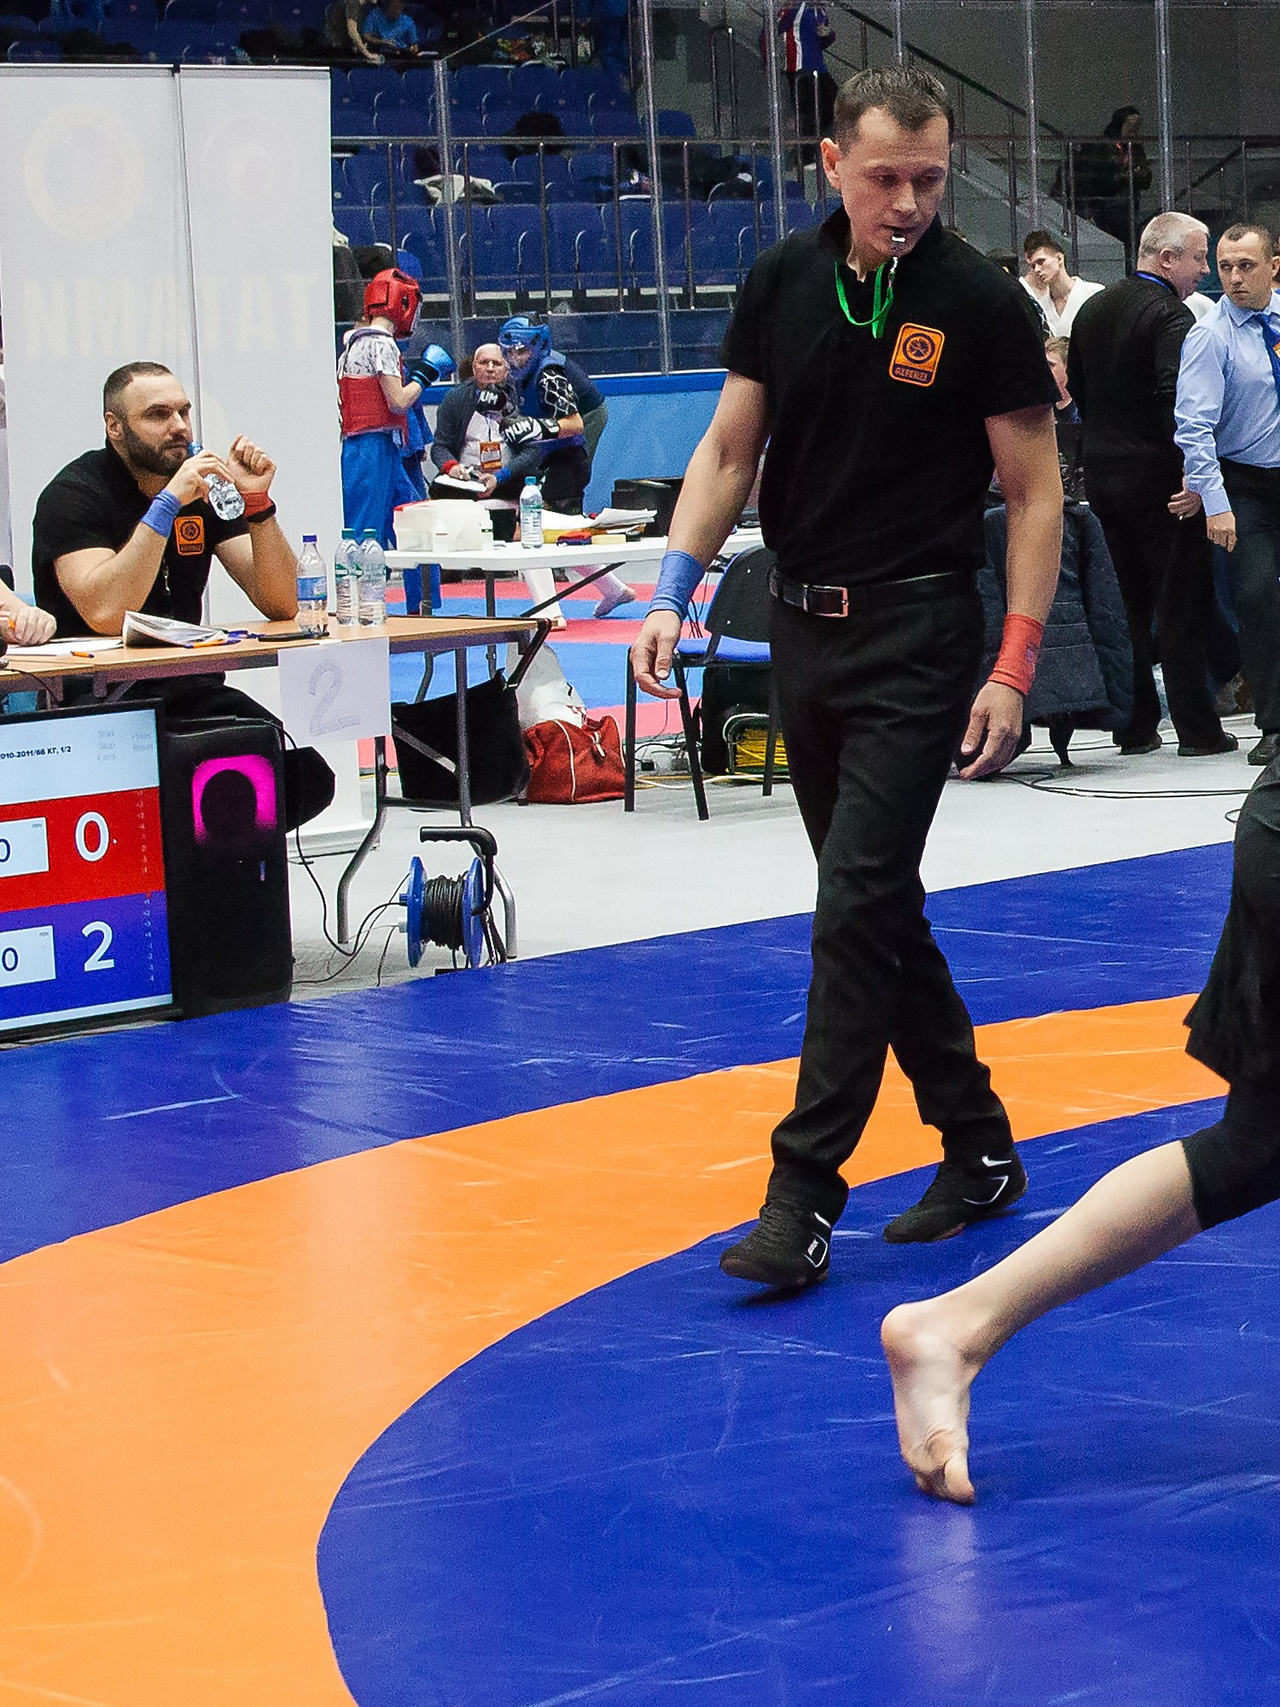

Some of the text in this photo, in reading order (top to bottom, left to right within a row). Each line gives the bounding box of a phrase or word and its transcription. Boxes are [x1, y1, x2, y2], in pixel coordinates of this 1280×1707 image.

[309, 660, 361, 737] 2
[60, 745, 72, 753] 1/2
[75, 811, 110, 862] 0
[2, 947, 19, 971] 0
[81, 920, 116, 972] 2
